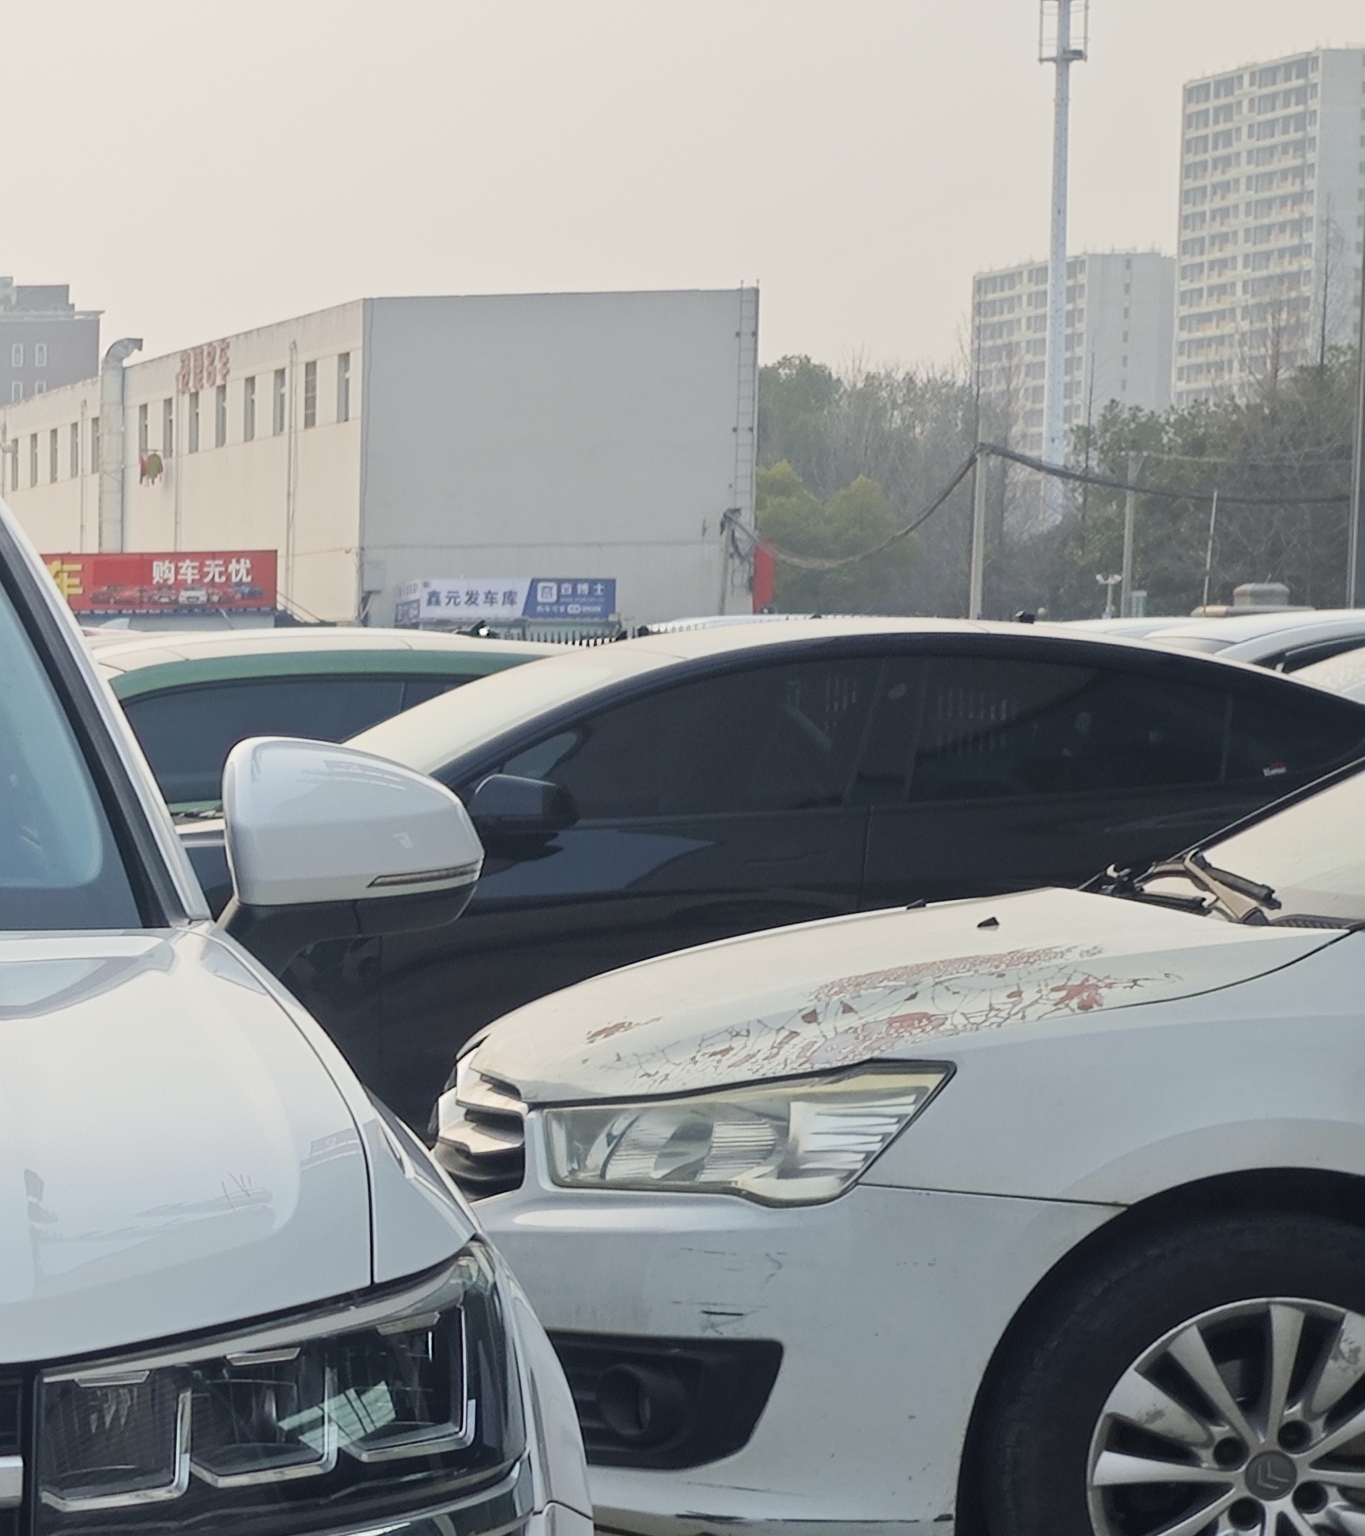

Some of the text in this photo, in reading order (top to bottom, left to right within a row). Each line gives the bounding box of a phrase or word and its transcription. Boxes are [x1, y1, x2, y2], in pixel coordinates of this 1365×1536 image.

[152, 558, 253, 585] 购车无忧
[426, 590, 519, 607] 鑫元发车库
